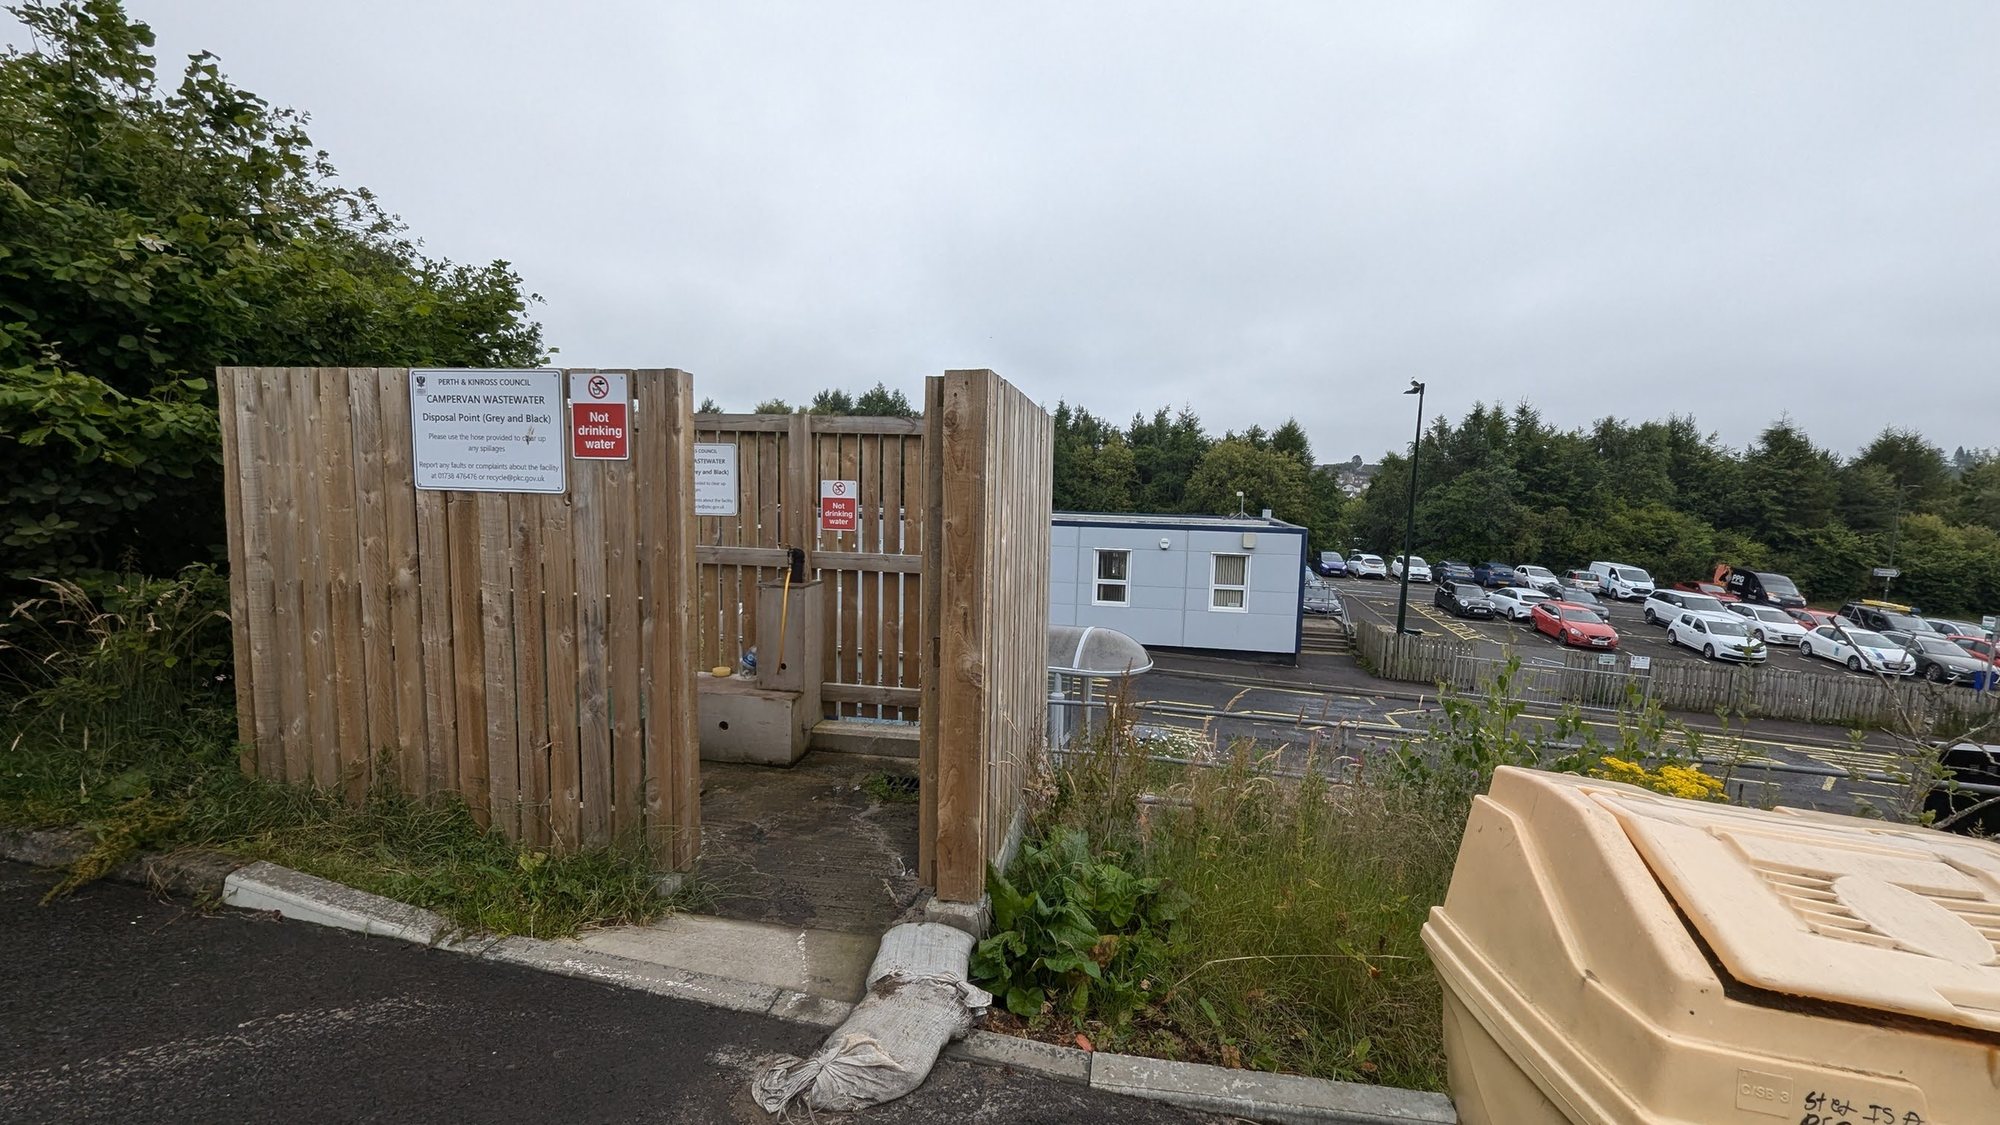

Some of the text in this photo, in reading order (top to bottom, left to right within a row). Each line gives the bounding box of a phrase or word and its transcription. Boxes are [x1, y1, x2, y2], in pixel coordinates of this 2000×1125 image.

[438, 378, 460, 386] PERTH
[467, 378, 498, 387] KINROSS
[499, 379, 531, 387] COUNCIL
[426, 394, 546, 405] CAMPERVAN WASTEWATER
[422, 412, 552, 425] Disposal Point (Grey and Black)
[589, 411, 610, 423] Not
[578, 424, 623, 439] drinking
[428, 432, 447, 441] Please
[459, 433, 470, 441] the
[470, 433, 485, 441] hose
[485, 434, 513, 443] provided
[513, 434, 521, 442] to
[537, 435, 547, 444] up
[468, 444, 506, 453] any spillages
[584, 439, 616, 450] water
[418, 460, 439, 470] Report
[439, 462, 451, 470] any
[450, 461, 467, 469] faults
[475, 463, 508, 471] complaints
[508, 463, 527, 471] about
[527, 463, 539, 471] the
[539, 463, 560, 472] facility
[486, 474, 546, 483] recycle@pkc.gov.uk
[832, 502, 846, 510] Not
[824, 510, 854, 519] drinking
